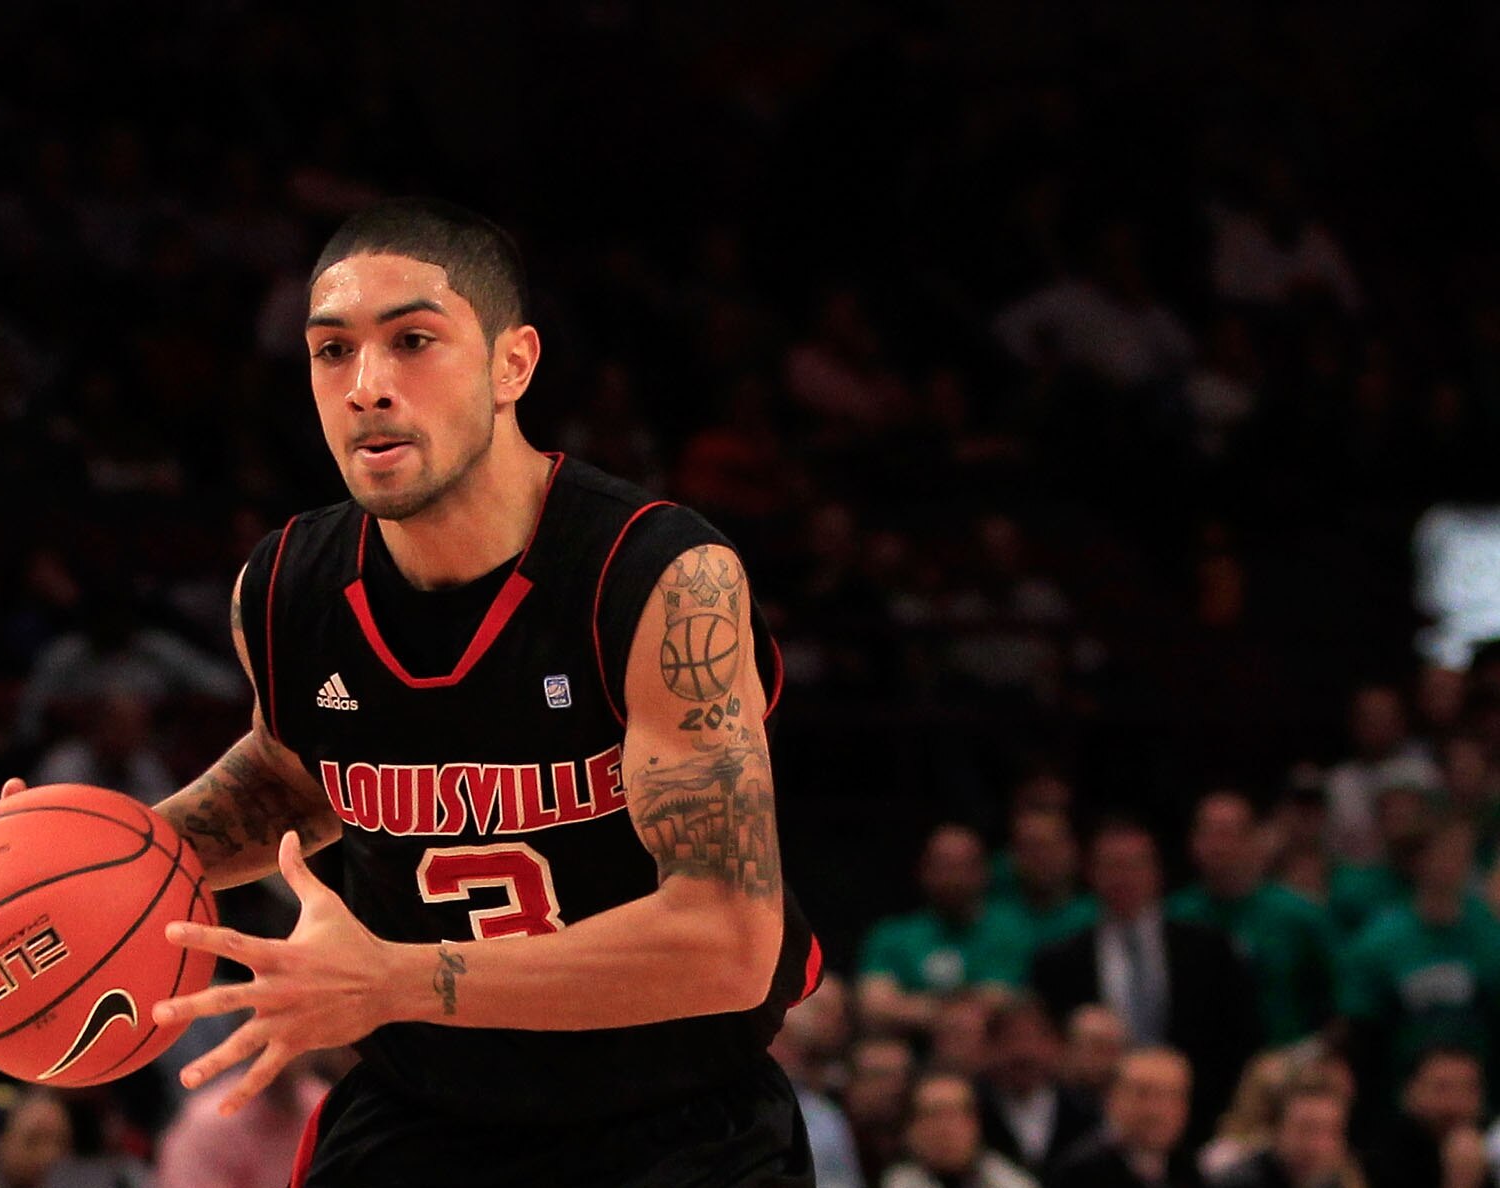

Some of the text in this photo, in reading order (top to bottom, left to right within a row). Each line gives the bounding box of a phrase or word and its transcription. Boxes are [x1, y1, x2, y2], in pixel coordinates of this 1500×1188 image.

[317, 696, 359, 711] adidas
[678, 695, 741, 732] 206
[319, 743, 628, 836] LOUISVILLE
[415, 841, 567, 943] 3
